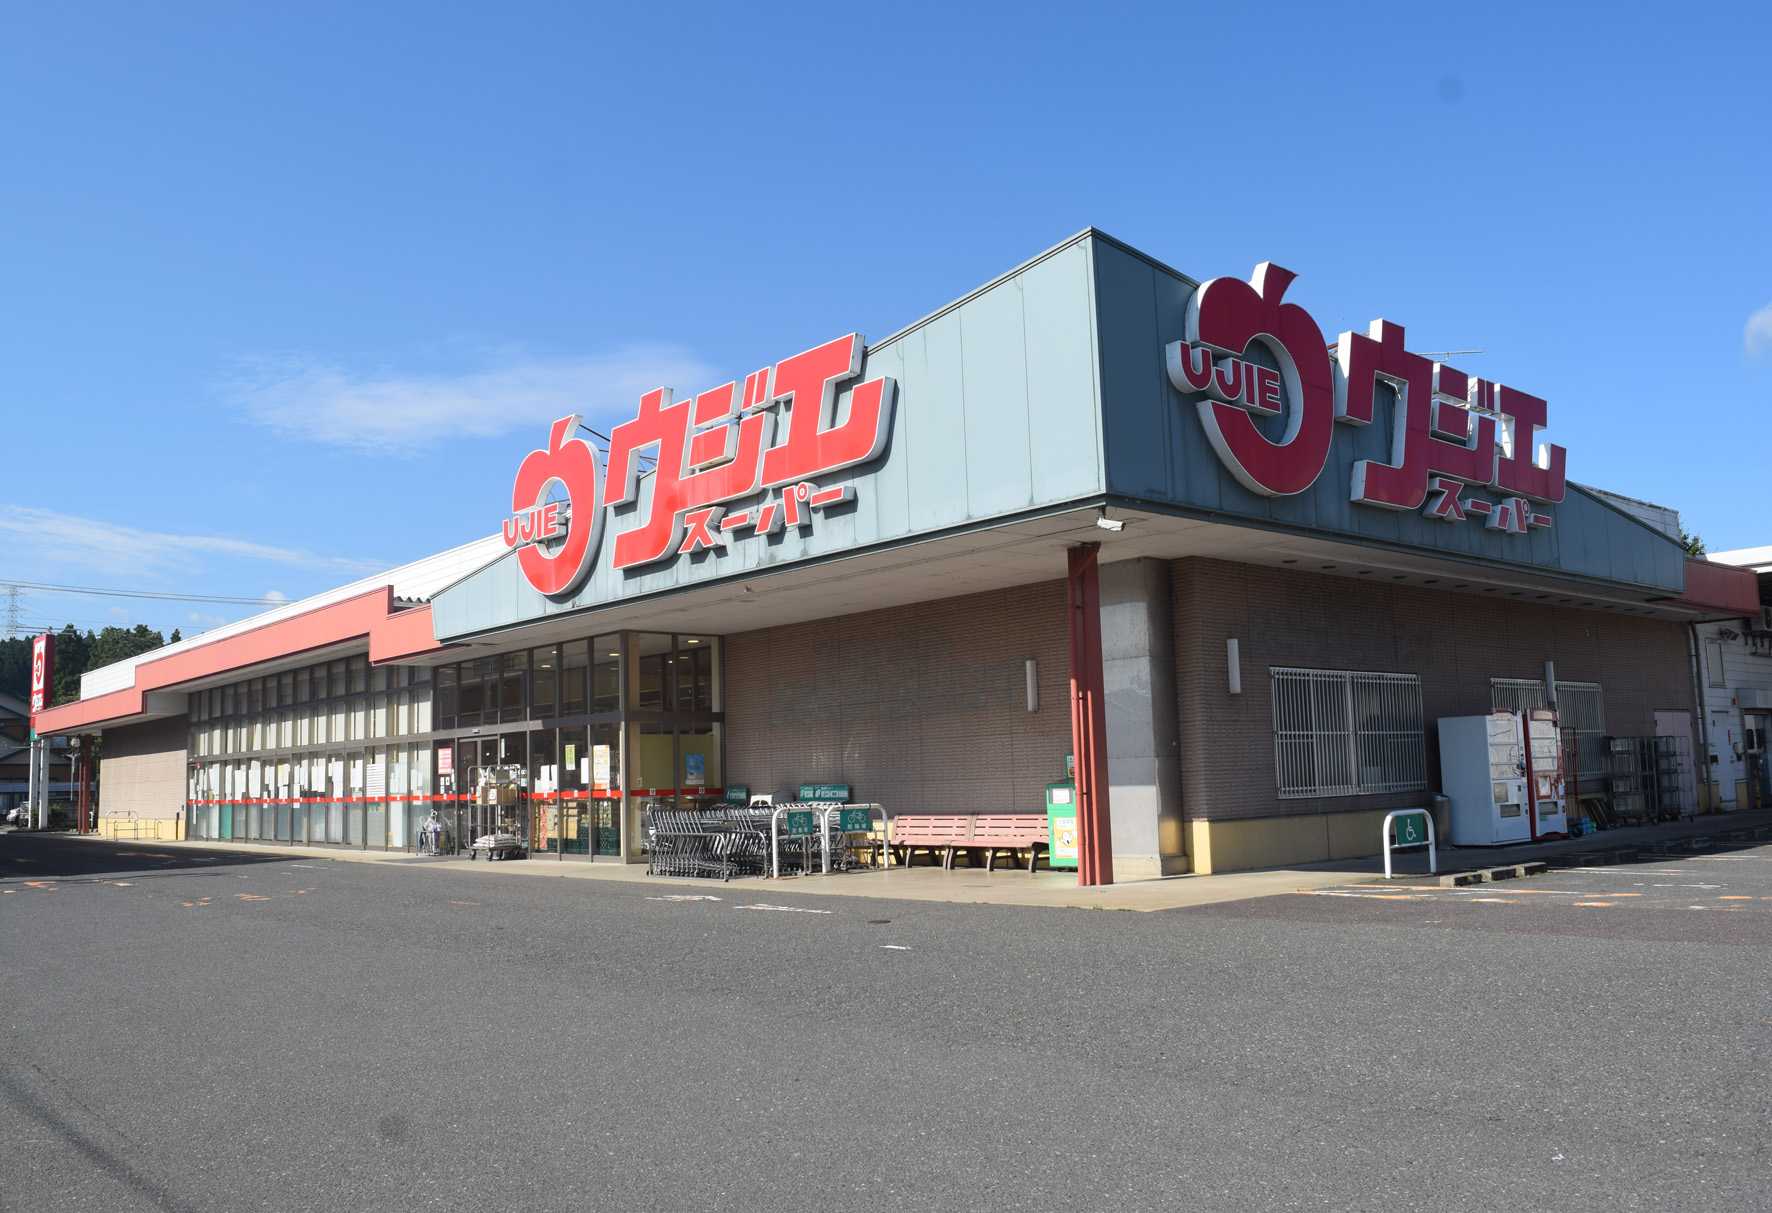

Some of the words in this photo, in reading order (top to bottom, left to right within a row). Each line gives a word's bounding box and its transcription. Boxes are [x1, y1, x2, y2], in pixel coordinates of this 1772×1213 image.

[1173, 340, 1281, 414] UJIE
[1338, 318, 1567, 510] ウジエ
[603, 332, 890, 570] ウジエ
[502, 502, 559, 549] UJIE
[678, 481, 846, 554] スーパー
[1428, 477, 1552, 533] スーパー
